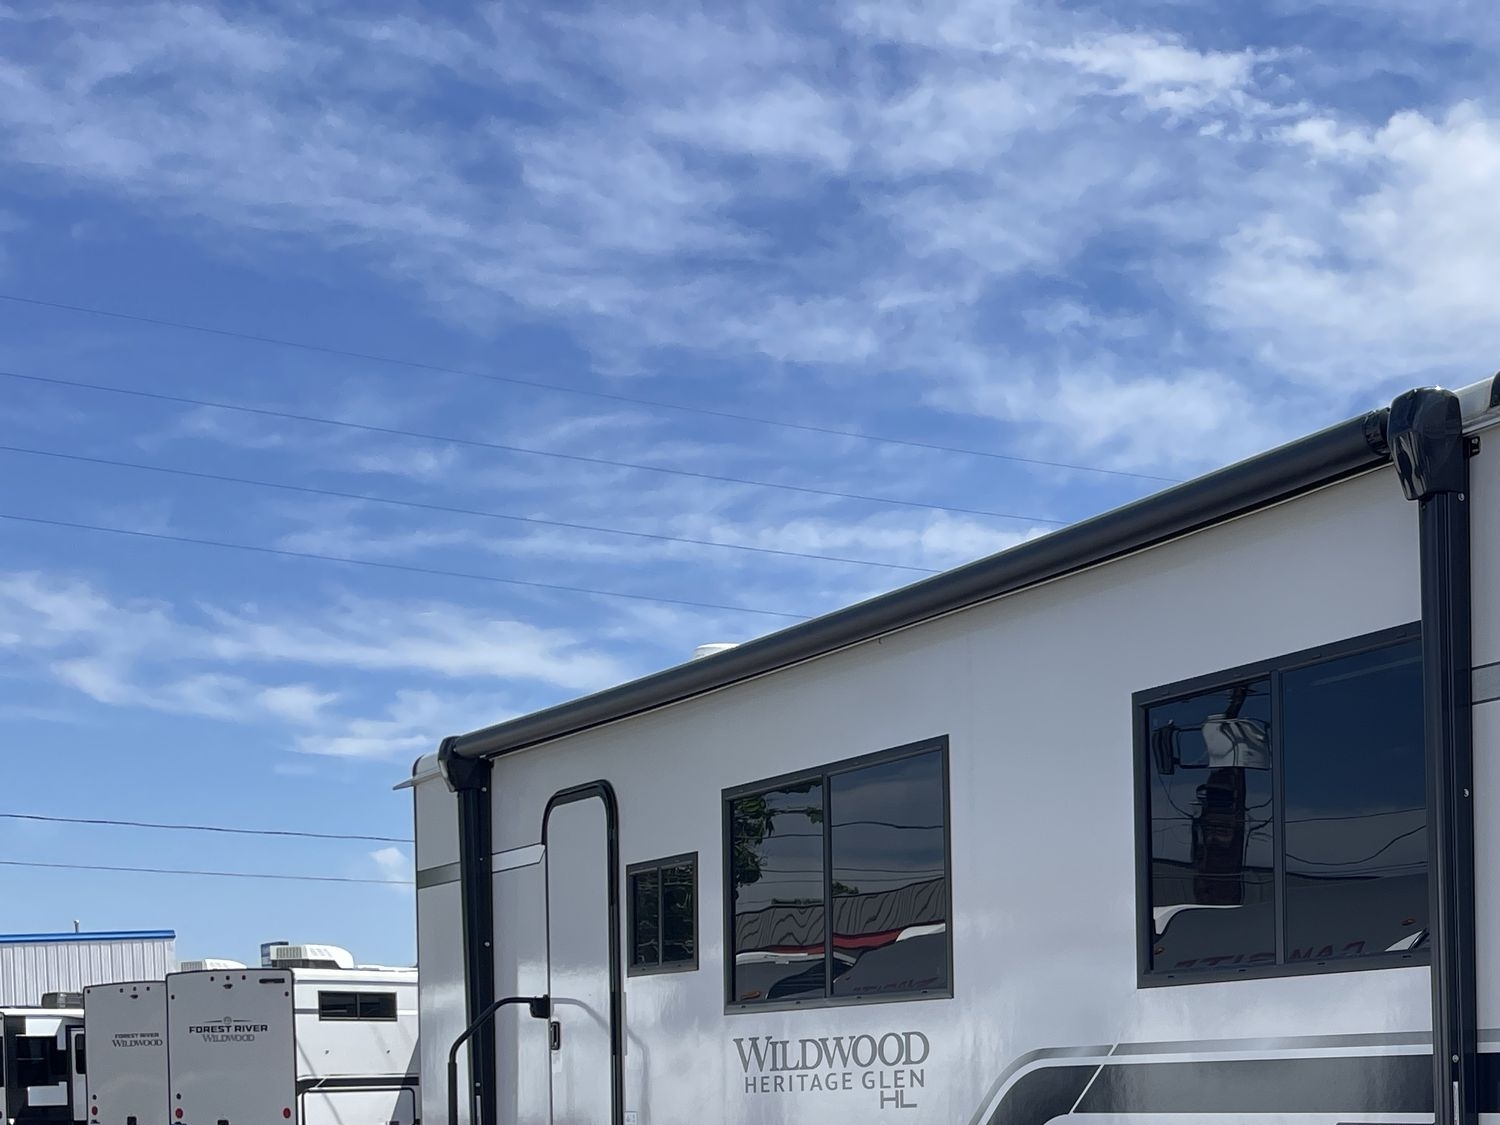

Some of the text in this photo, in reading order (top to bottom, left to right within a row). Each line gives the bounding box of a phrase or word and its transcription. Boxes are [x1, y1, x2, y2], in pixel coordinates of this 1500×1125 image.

[189, 1024, 268, 1033] FOREST RIVER
[112, 1039, 164, 1048] WILDWOOD
[202, 1034, 255, 1043] WILDWOOD
[732, 1031, 930, 1073] WILDWOOD
[744, 1069, 925, 1094] HERITAGE GLEN
[880, 1089, 918, 1109] HL
